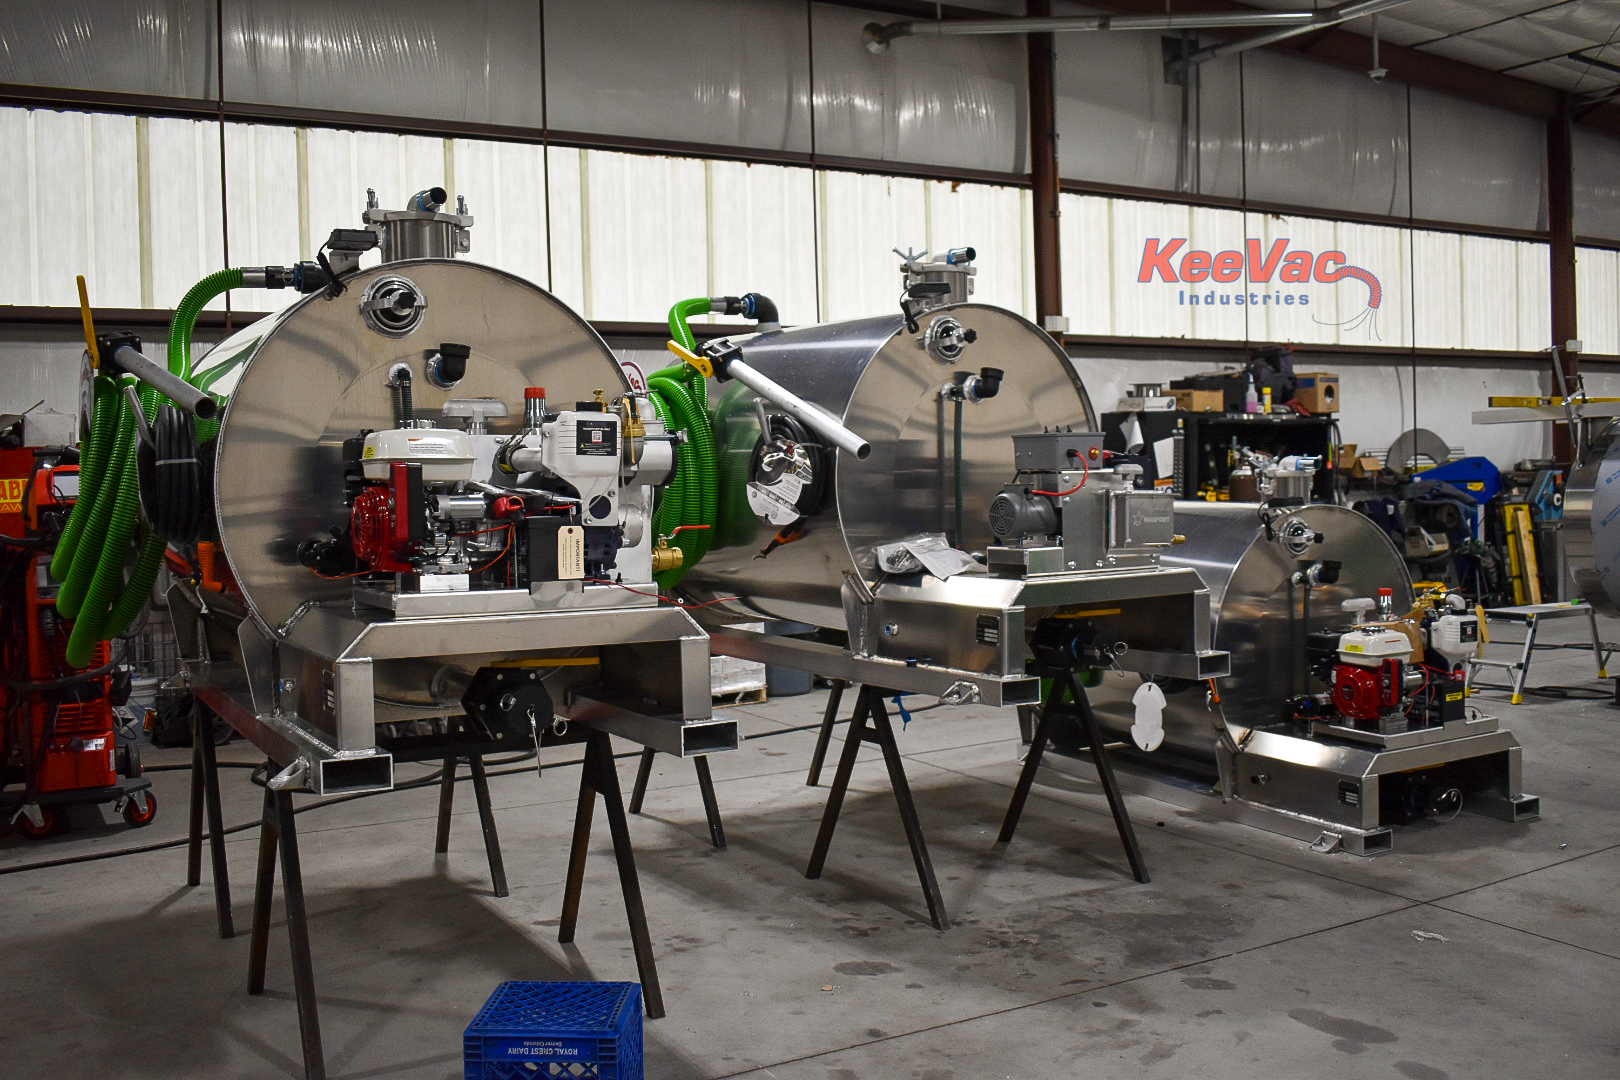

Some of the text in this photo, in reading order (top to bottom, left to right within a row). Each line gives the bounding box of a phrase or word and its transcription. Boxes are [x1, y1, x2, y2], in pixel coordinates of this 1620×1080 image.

[507, 1047, 578, 1056] ROYAL CREST DAIRY
